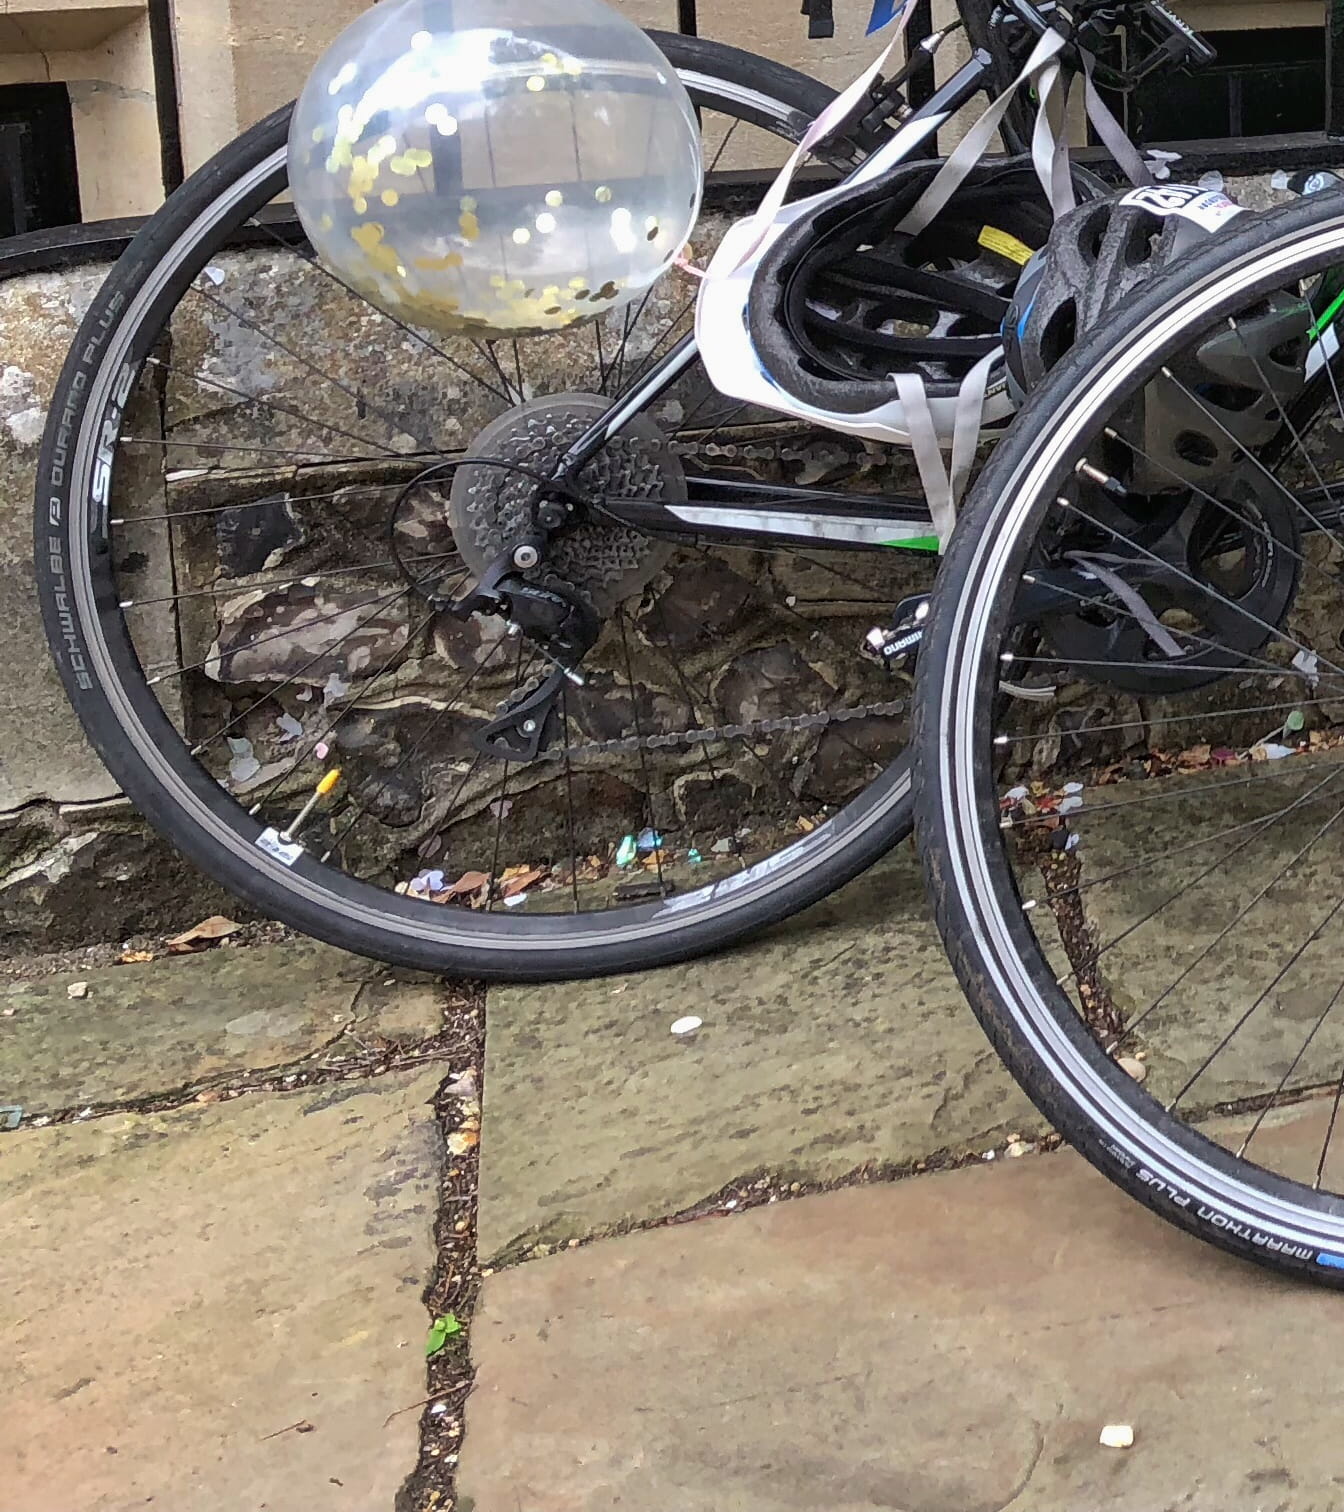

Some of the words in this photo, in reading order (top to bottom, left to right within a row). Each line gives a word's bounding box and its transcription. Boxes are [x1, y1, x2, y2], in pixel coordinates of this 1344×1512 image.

[82, 289, 126, 364] PLUS
[51, 372, 87, 485] DURANO
[88, 362, 136, 505] SR-2
[49, 536, 94, 689] SCHWALBE
[1134, 1167, 1190, 1206] PLUS
[1198, 1205, 1312, 1259] MARATHON
